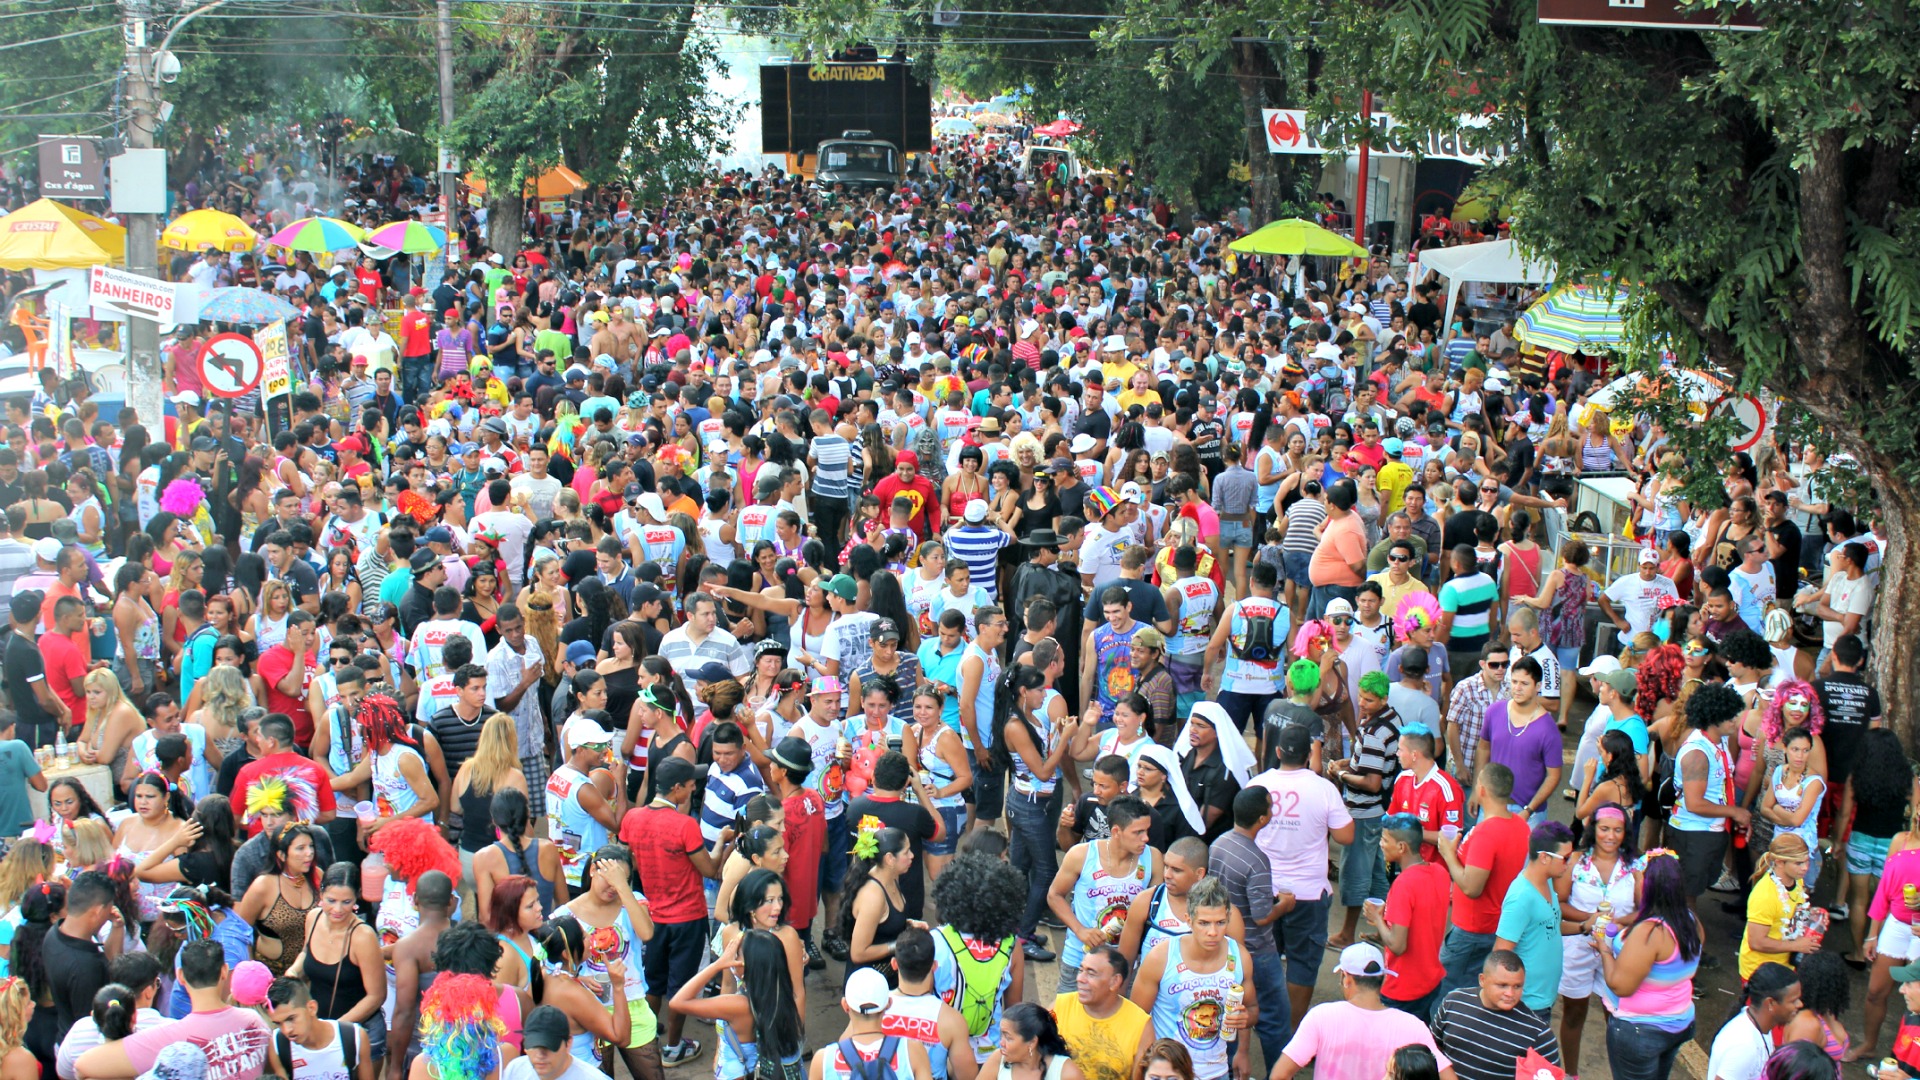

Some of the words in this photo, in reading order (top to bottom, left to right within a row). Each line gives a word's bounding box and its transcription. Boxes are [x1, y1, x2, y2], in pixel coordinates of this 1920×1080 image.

[63, 170, 82, 179] Pça
[44, 181, 62, 190] Cxs
[63, 181, 95, 192] d'água
[104, 271, 175, 295] Rondoniaovivo.com
[93, 280, 173, 311] BANHEIROS
[645, 531, 671, 541] CAPRI
[1185, 583, 1208, 595] CAPRI
[1543, 659, 1552, 690] bozzano
[1824, 686, 1869, 697] SPORTSMEN
[1844, 699, 1866, 708] JERSEY
[1168, 976, 1217, 995] Carnaval
[1193, 988, 1220, 1001] BANDA
[881, 1015, 935, 1037] CAPRI
